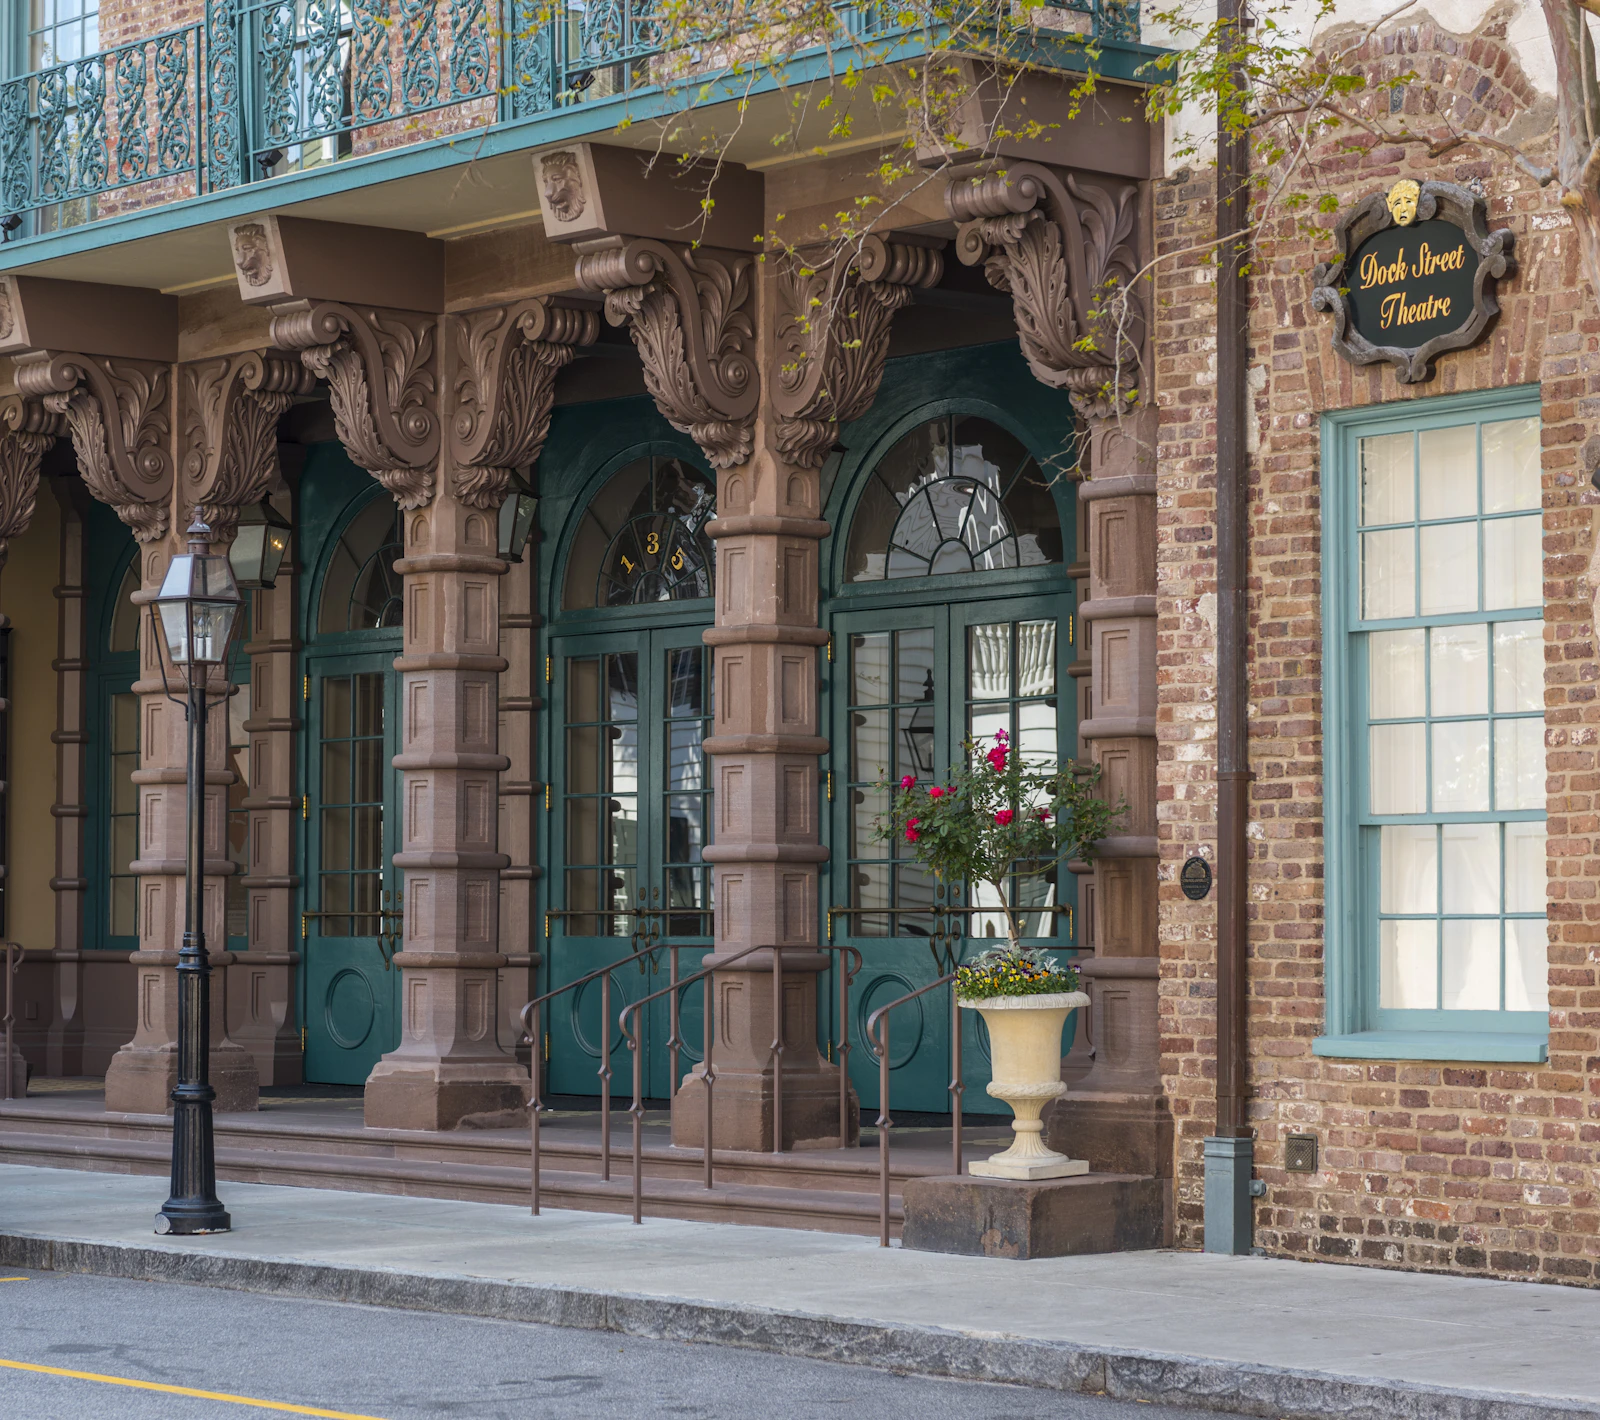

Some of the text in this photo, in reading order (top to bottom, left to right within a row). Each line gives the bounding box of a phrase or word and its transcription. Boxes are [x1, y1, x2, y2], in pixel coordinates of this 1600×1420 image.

[1359, 242, 1466, 290] Dock Street
[1380, 291, 1452, 330] Theatre
[620, 532, 687, 575] 135
